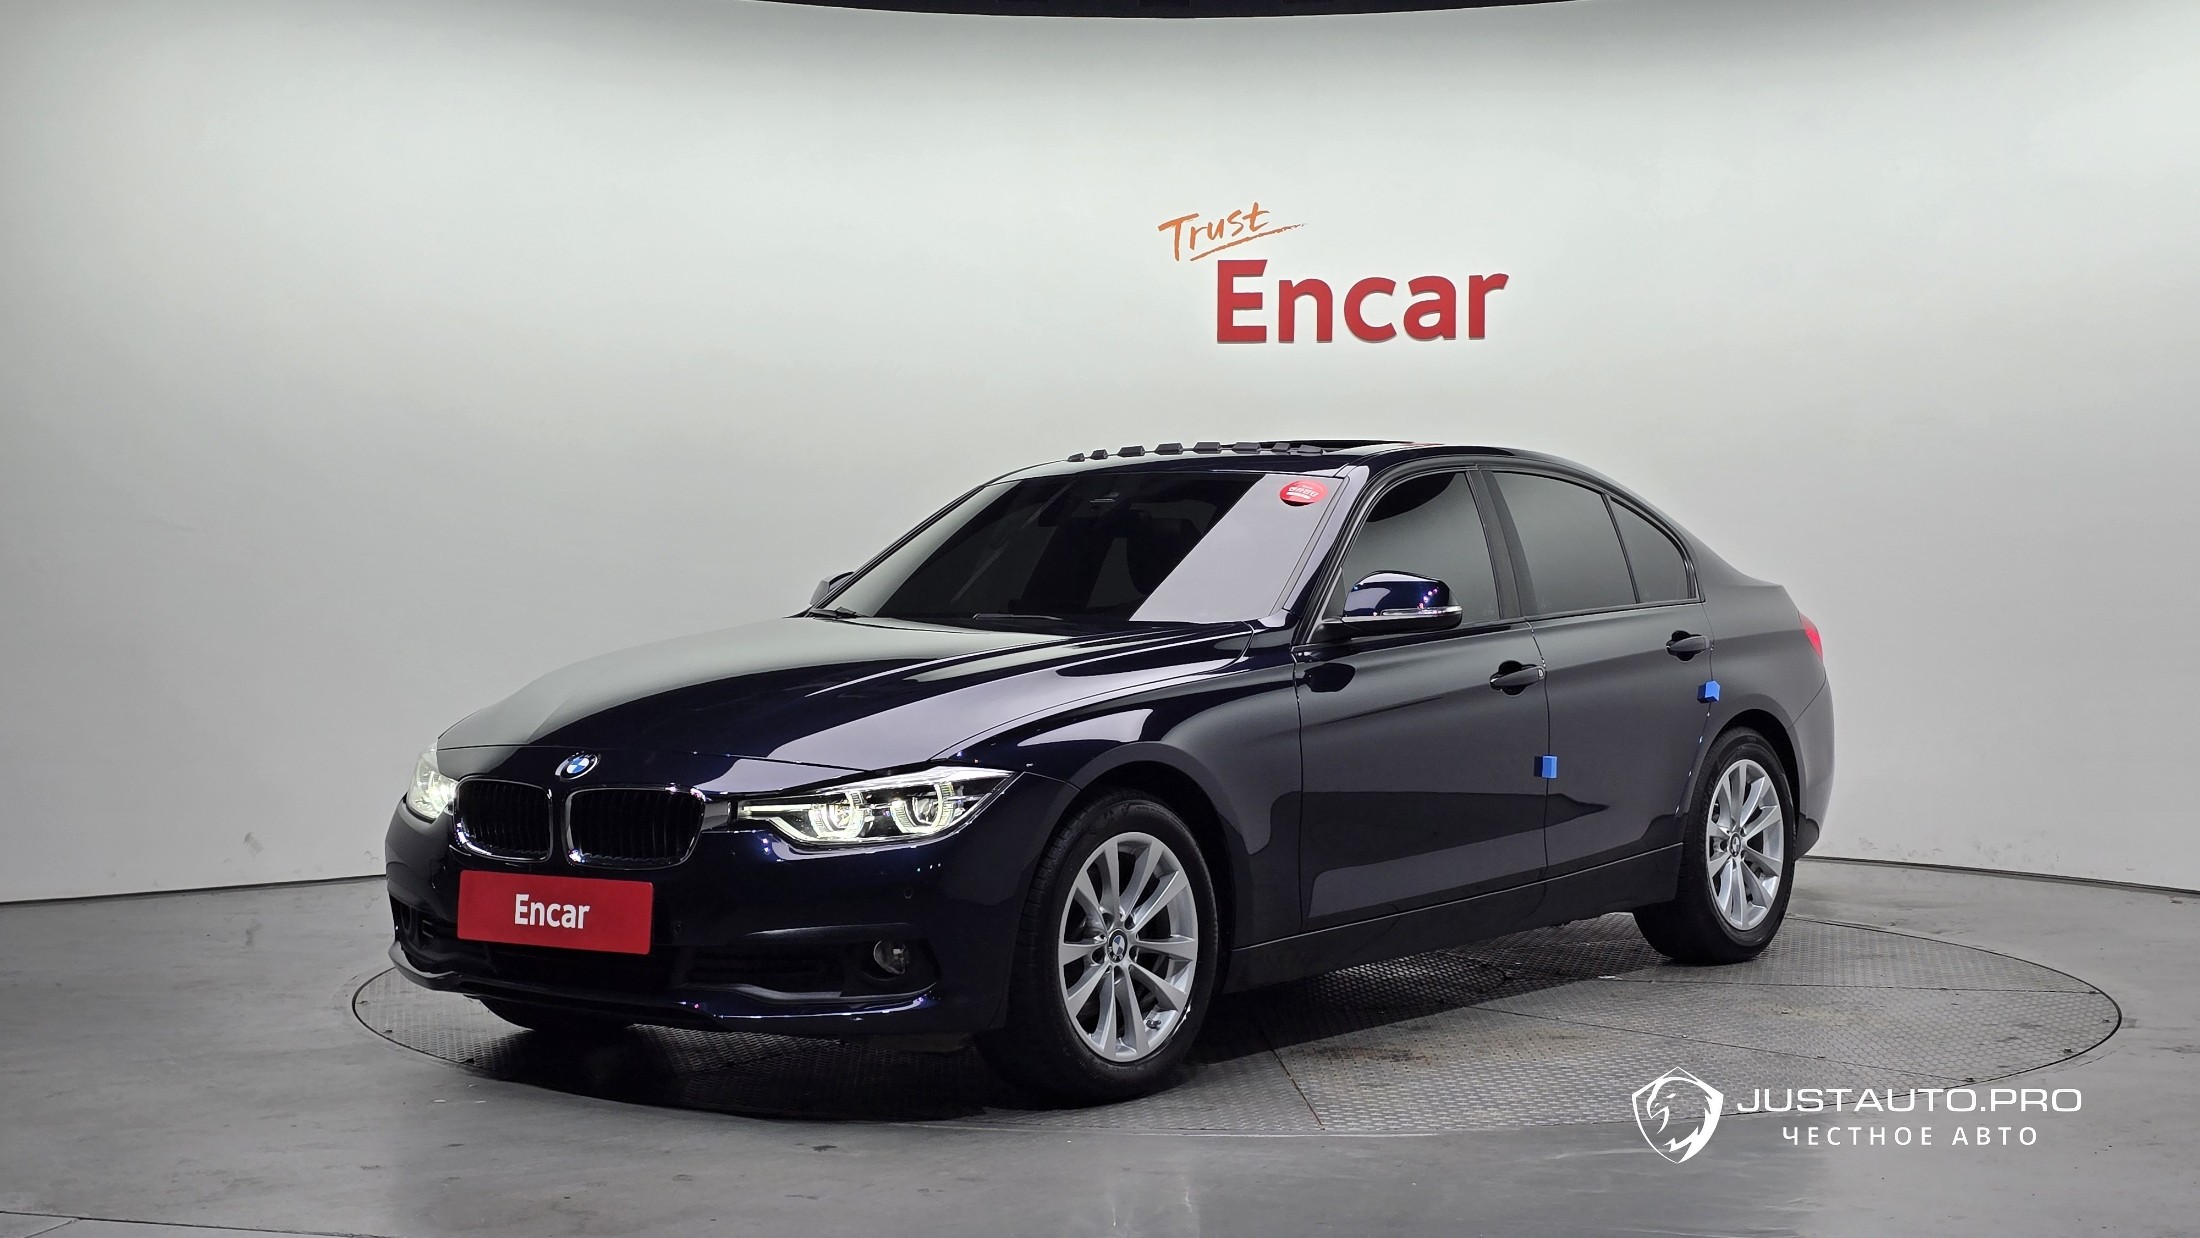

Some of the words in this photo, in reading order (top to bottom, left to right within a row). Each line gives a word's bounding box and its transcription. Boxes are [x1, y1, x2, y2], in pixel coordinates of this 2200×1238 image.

[1158, 202, 1269, 261] Trust
[1217, 259, 1509, 343] Encar
[515, 893, 590, 929] Encar
